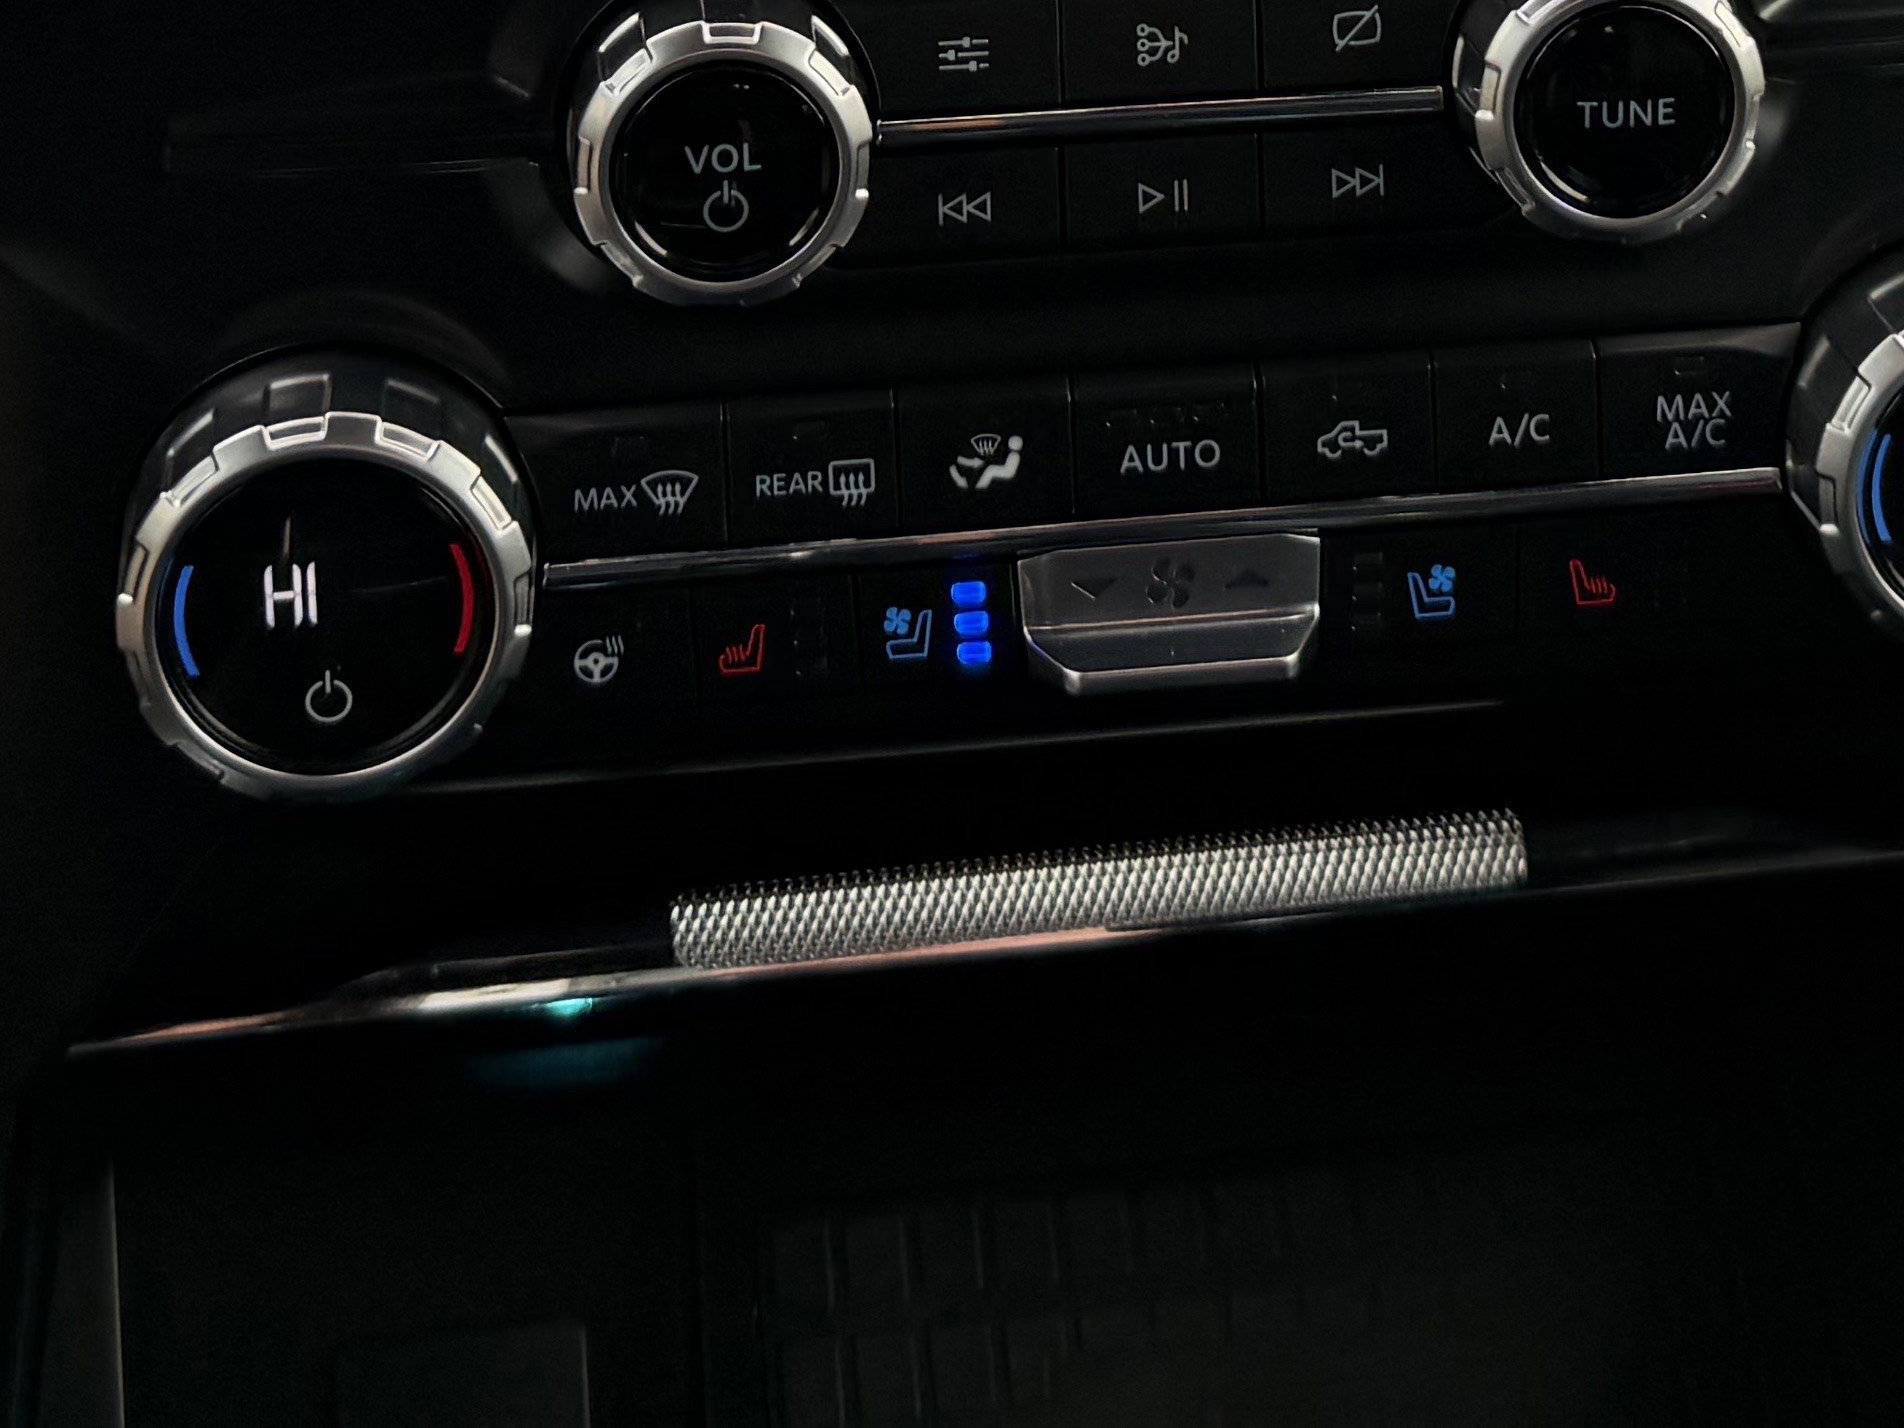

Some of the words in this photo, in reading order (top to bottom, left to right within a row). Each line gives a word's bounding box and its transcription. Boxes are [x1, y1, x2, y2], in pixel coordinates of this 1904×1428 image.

[1576, 97, 1676, 130] TUNE
[684, 143, 762, 175] VOL
[1656, 391, 1732, 422] MAX
[1489, 411, 1551, 447] A/C
[1664, 418, 1727, 450] A/C
[1120, 439, 1221, 475] AUTO
[574, 485, 638, 513] MAX
[755, 470, 824, 498] REAR
[263, 561, 318, 629] HI
